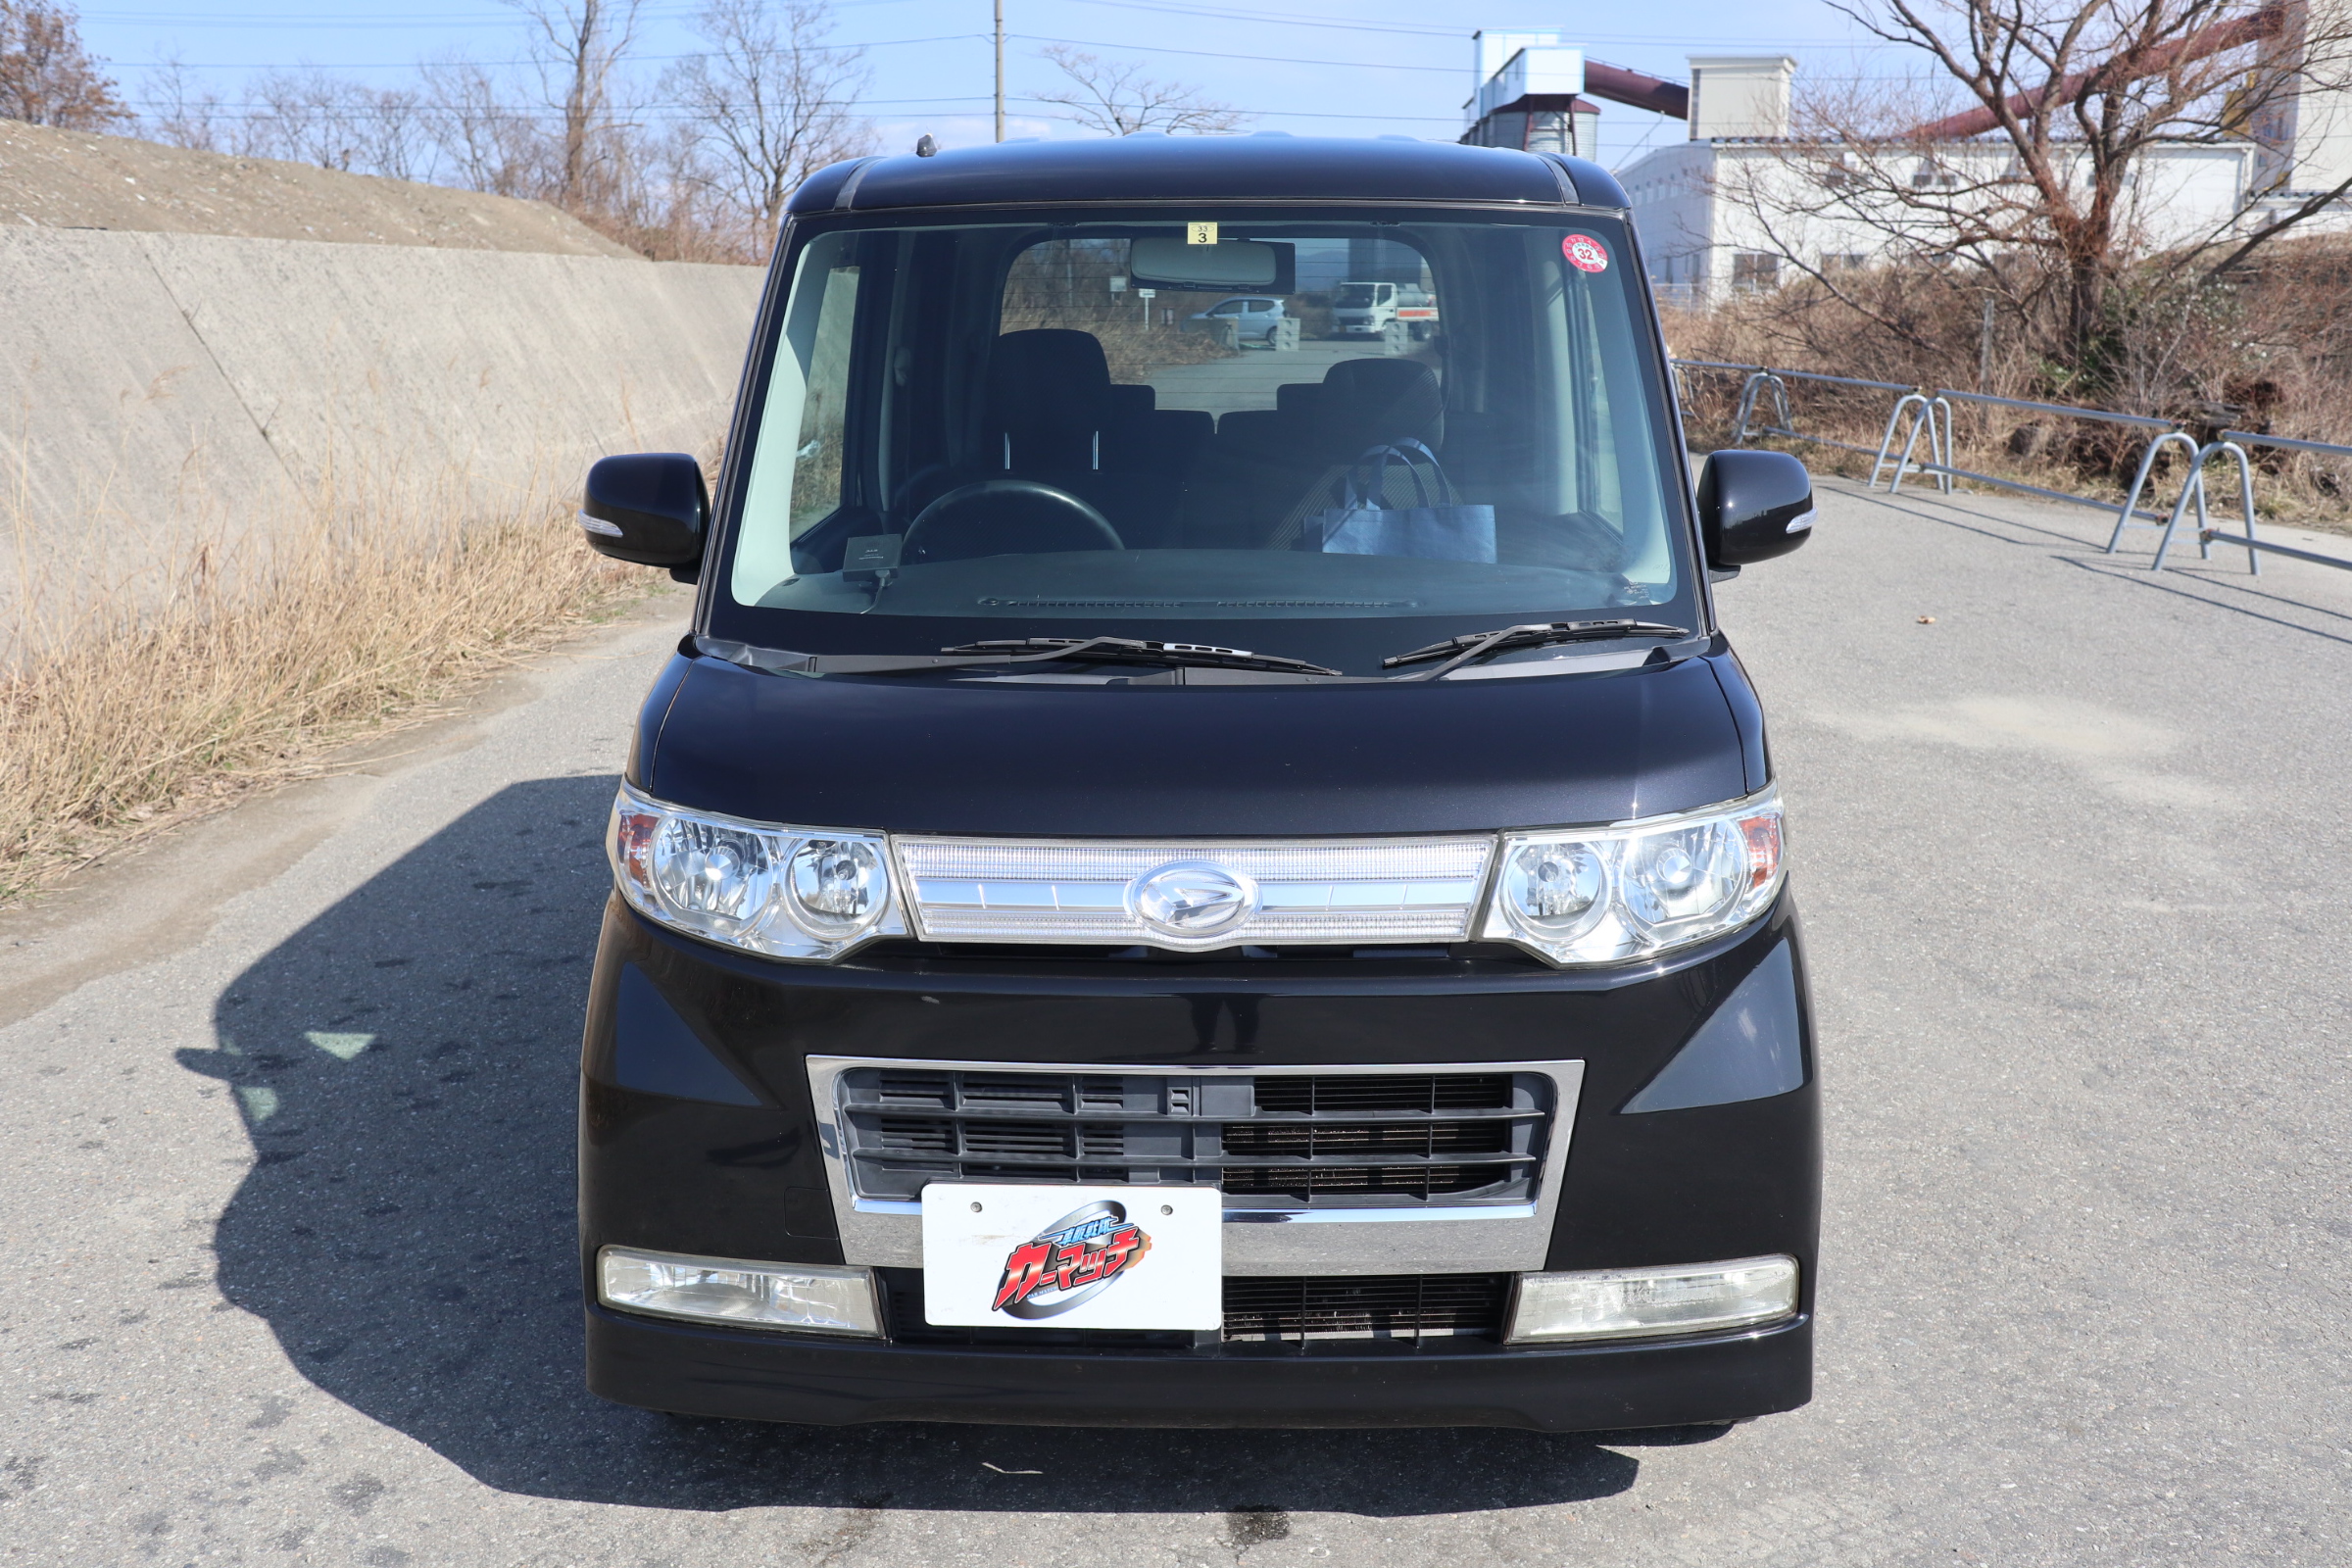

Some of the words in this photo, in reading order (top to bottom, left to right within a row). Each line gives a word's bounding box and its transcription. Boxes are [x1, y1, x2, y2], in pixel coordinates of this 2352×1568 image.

[1198, 232, 1207, 243] 3
[1577, 248, 1594, 260] 32
[993, 1227, 1139, 1310] カーマッチ
